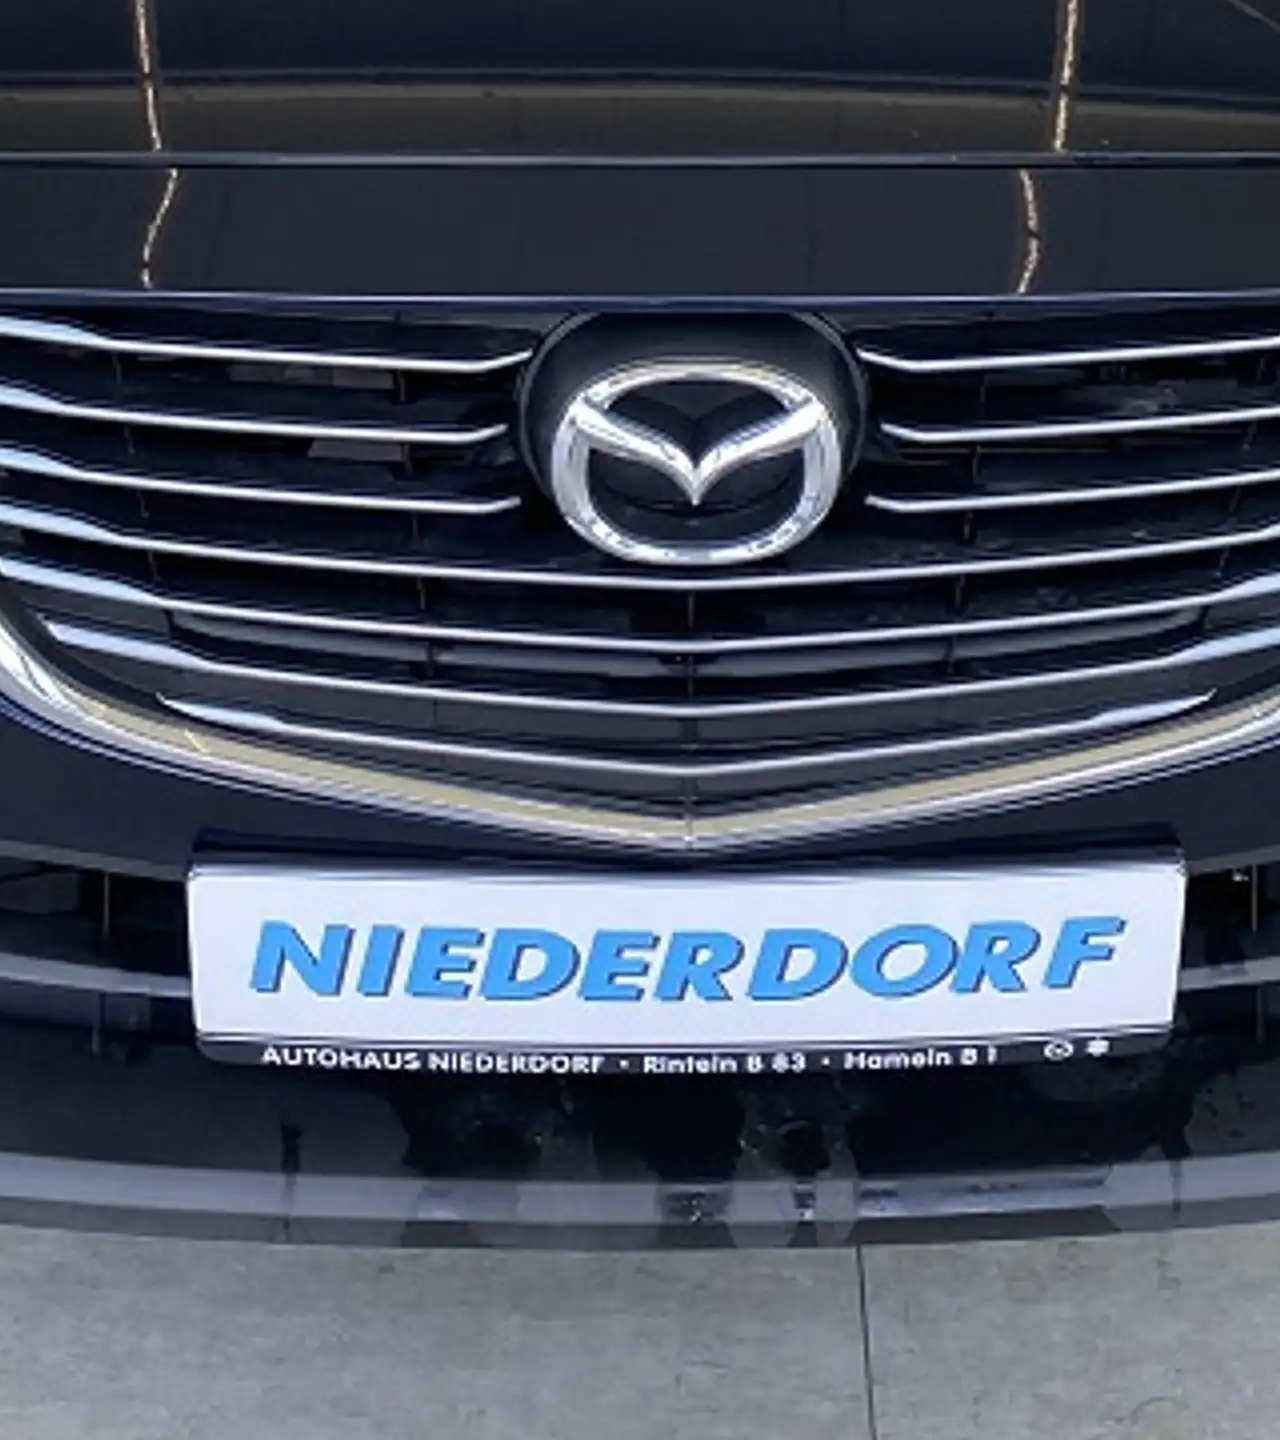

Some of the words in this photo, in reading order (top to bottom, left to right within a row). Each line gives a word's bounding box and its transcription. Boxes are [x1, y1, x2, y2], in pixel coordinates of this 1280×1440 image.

[249, 917, 1126, 1002] NIEDERDORF
[262, 1046, 421, 1071] AUTOHAUS
[427, 1050, 605, 1074] NIEDERDORF
